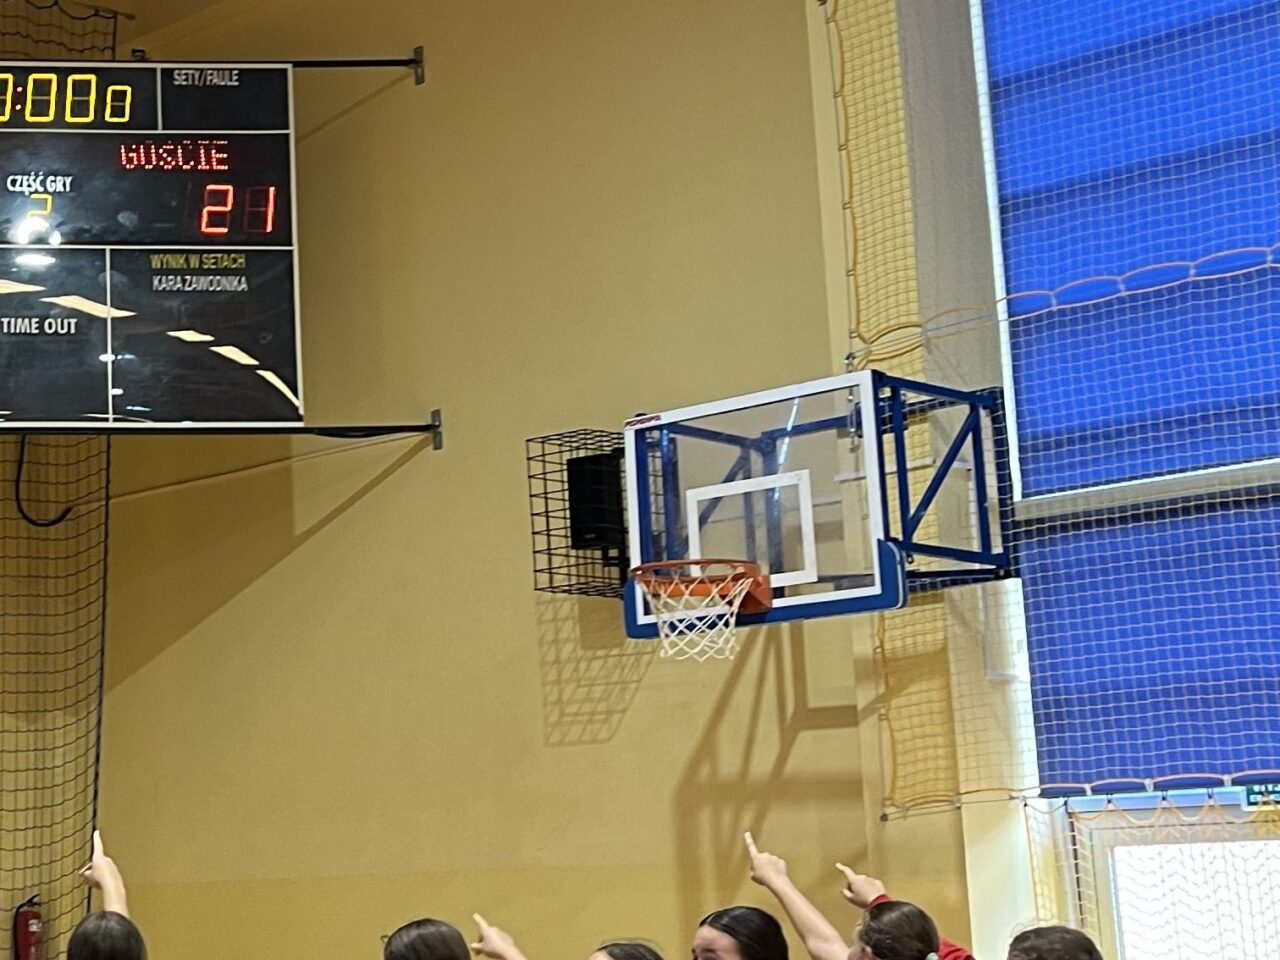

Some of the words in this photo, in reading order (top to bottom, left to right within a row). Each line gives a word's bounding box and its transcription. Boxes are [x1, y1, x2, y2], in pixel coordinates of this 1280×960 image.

[173, 69, 239, 86] SETY/FAULE
[6, 171, 45, 196] CZĘŚĆ
[46, 175, 73, 192] GRY
[201, 184, 276, 233] 21
[150, 254, 188, 269] WYNIK
[189, 254, 200, 269] W
[202, 254, 246, 269] SETACH
[152, 275, 183, 291] KARA
[184, 275, 248, 291] ZAWODNIKA
[1, 317, 40, 334] TIME
[44, 317, 78, 334] OUT
